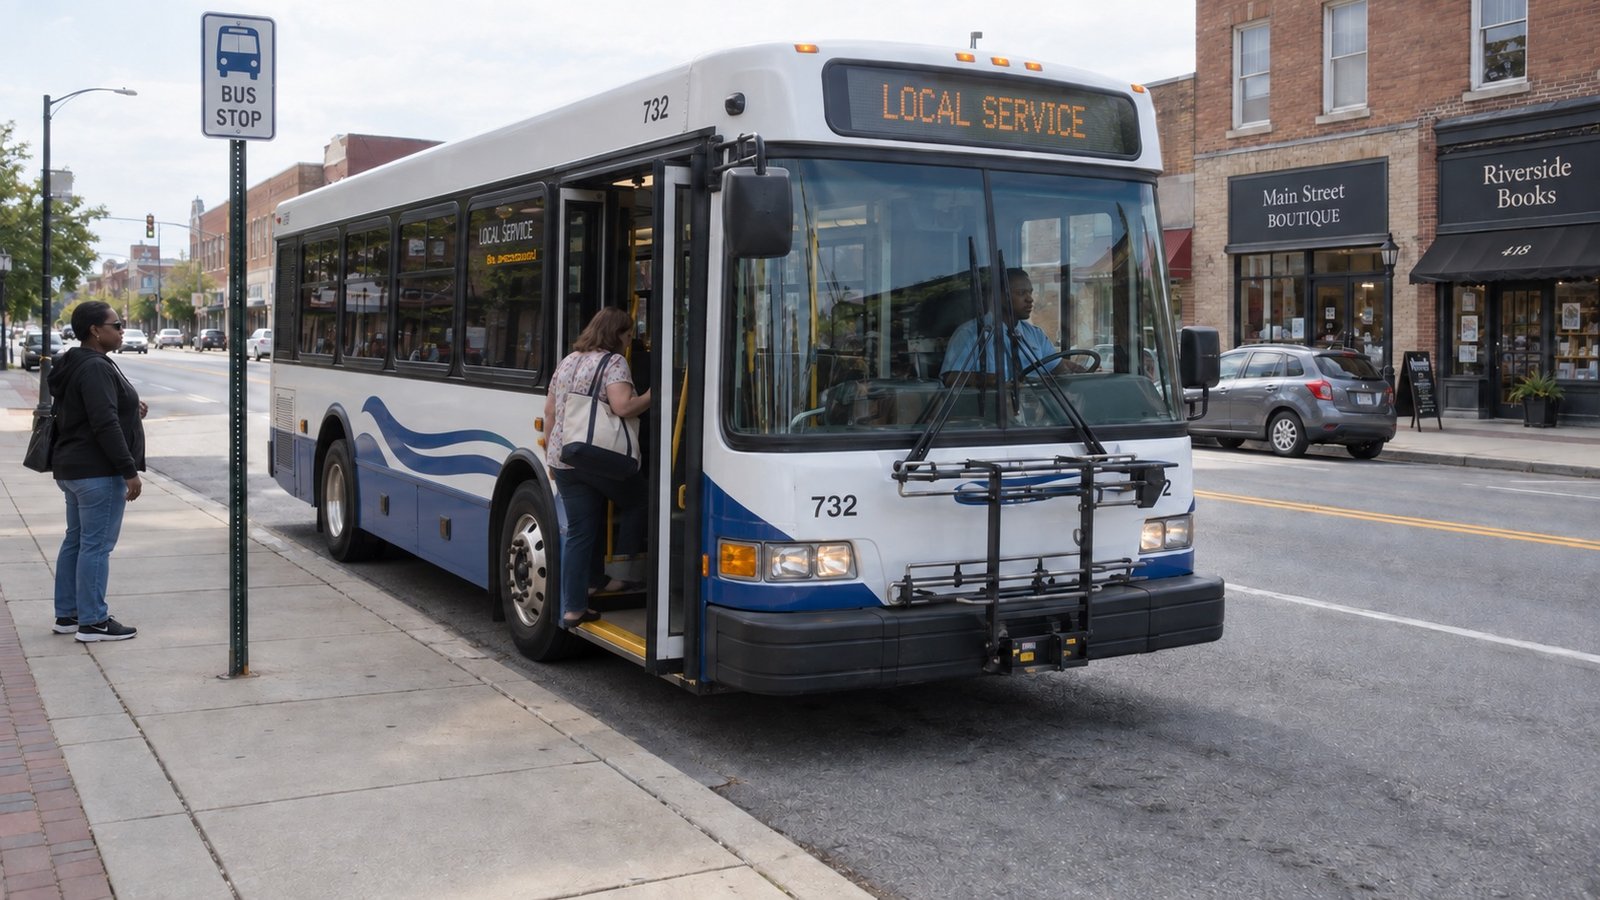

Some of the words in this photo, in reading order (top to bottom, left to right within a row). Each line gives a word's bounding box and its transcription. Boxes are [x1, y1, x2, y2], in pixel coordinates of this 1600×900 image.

[222, 85, 256, 104] BUS
[216, 108, 262, 128] STOP
[643, 94, 669, 124] 732
[882, 83, 970, 127] LOCAL
[982, 95, 1085, 138] SERVICE
[1483, 156, 1572, 185] Riverside
[1262, 187, 1298, 207] Main
[1302, 183, 1345, 203] Street
[1497, 184, 1557, 209] Books
[1267, 208, 1341, 229] BOUTIQUE
[479, 226, 500, 245] LOCAL
[502, 220, 533, 243] SERVICE
[1501, 244, 1532, 257] 418
[811, 494, 858, 518] 732
